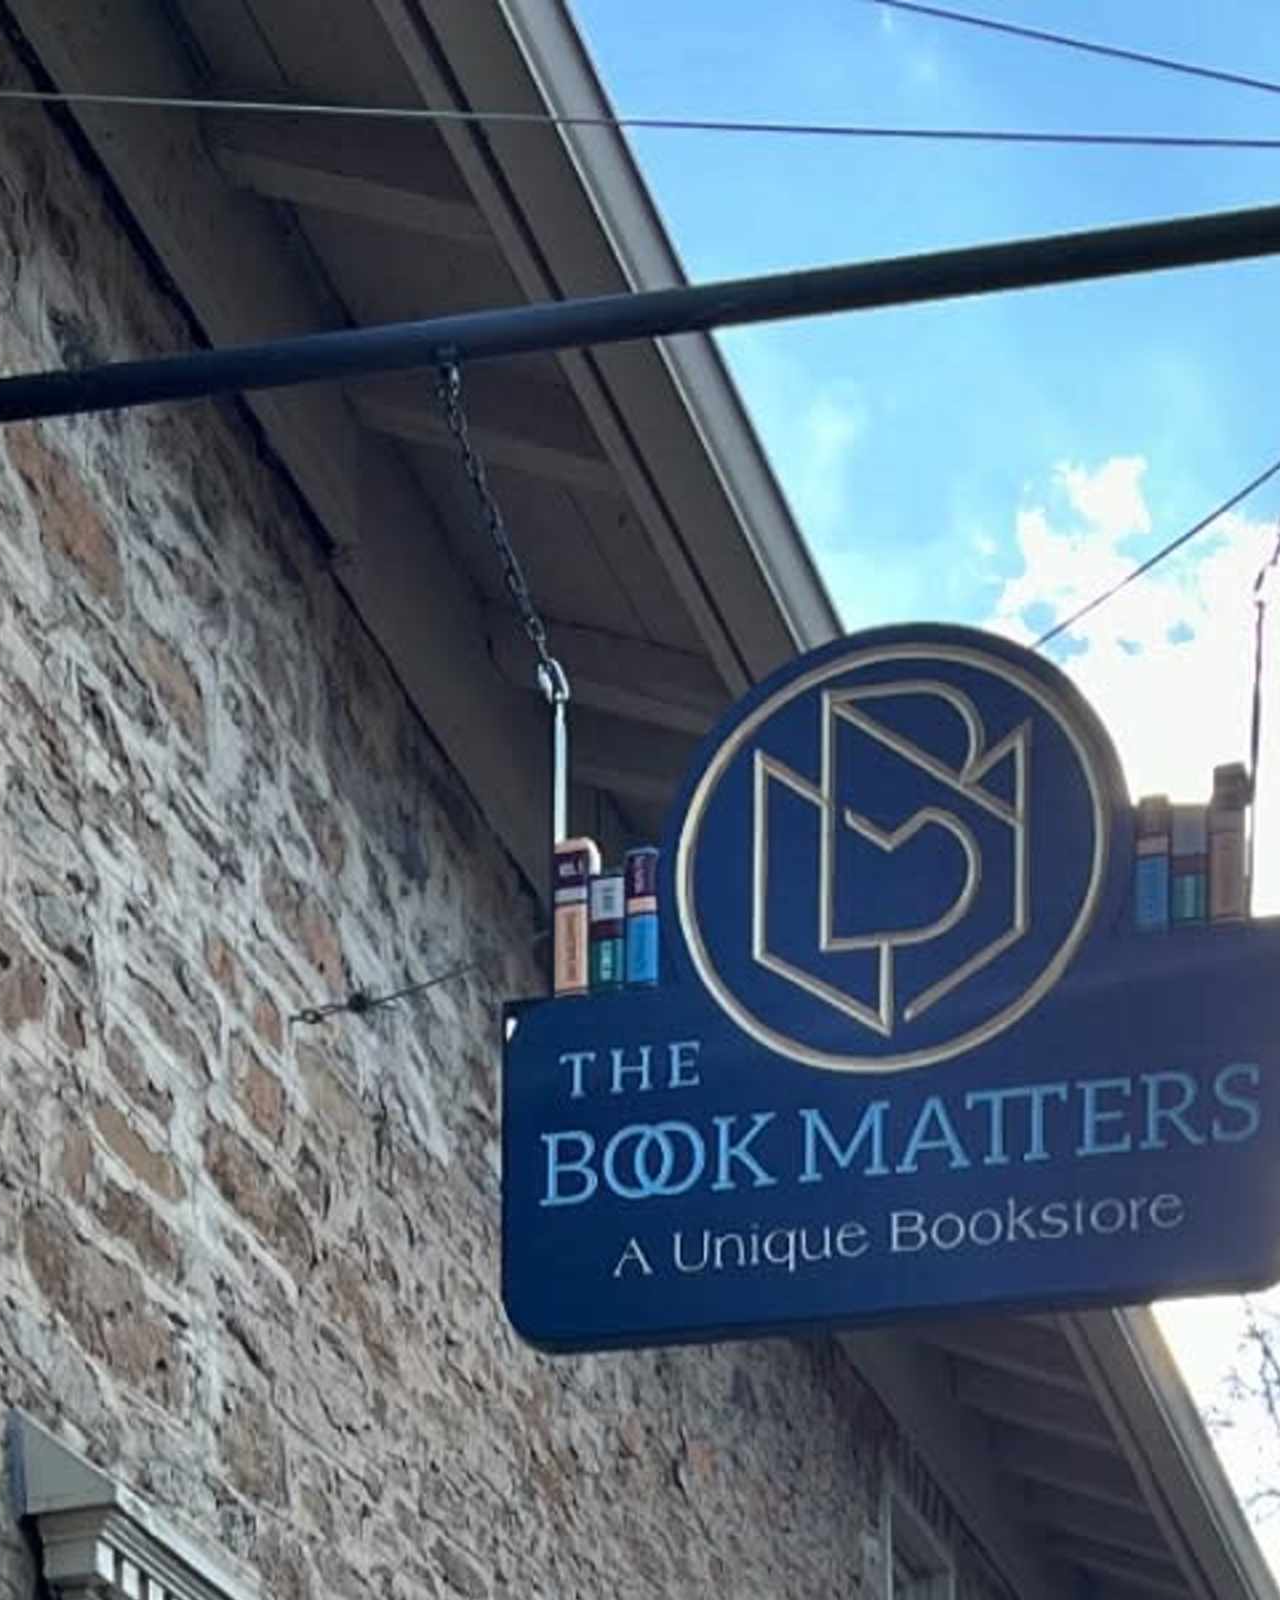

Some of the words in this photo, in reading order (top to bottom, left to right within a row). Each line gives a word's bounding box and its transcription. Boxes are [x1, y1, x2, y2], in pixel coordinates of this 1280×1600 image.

[560, 1041, 702, 1101] THE
[539, 1112, 779, 1208] BOOK
[798, 1063, 1264, 1186] MATTERS
[612, 1243, 653, 1279] A
[671, 1220, 871, 1273] Unique
[889, 1191, 1186, 1254] Bookstore
